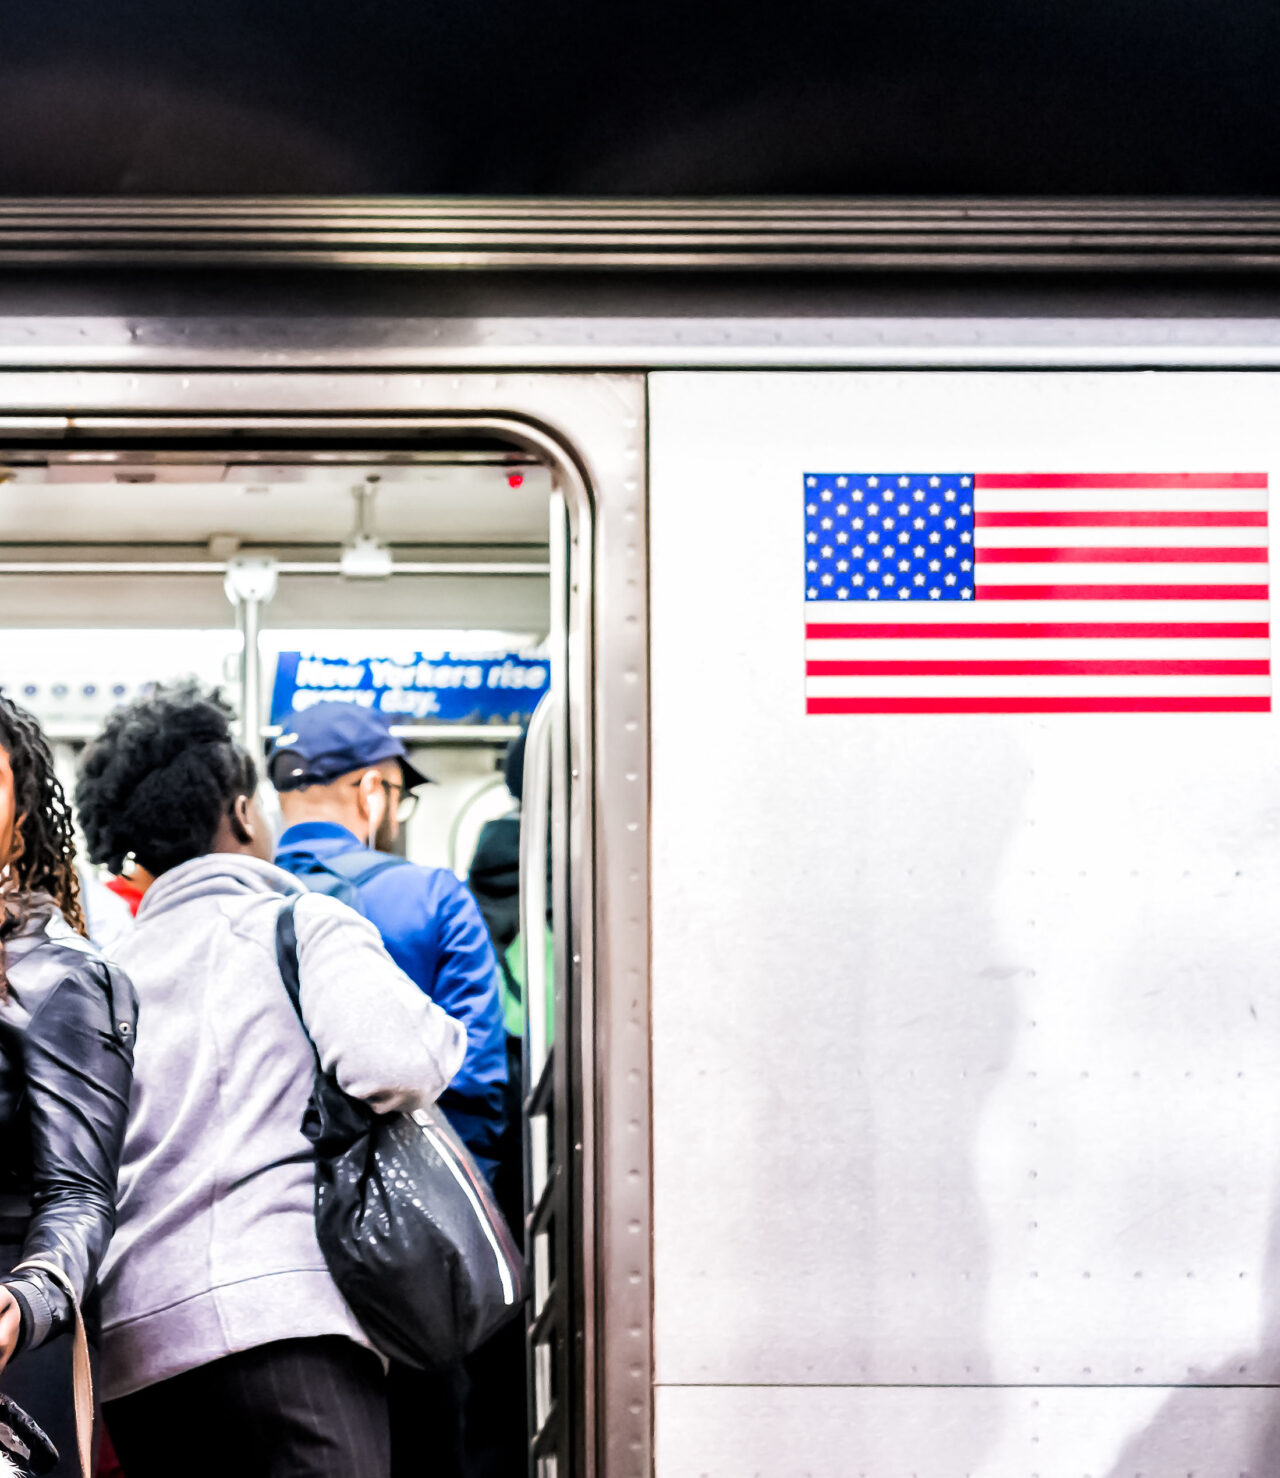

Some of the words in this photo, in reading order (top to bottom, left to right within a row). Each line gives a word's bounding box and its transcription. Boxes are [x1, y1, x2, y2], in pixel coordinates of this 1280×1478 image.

[296, 660, 365, 687] New
[370, 660, 482, 689] Yorkers
[487, 660, 547, 689] rise
